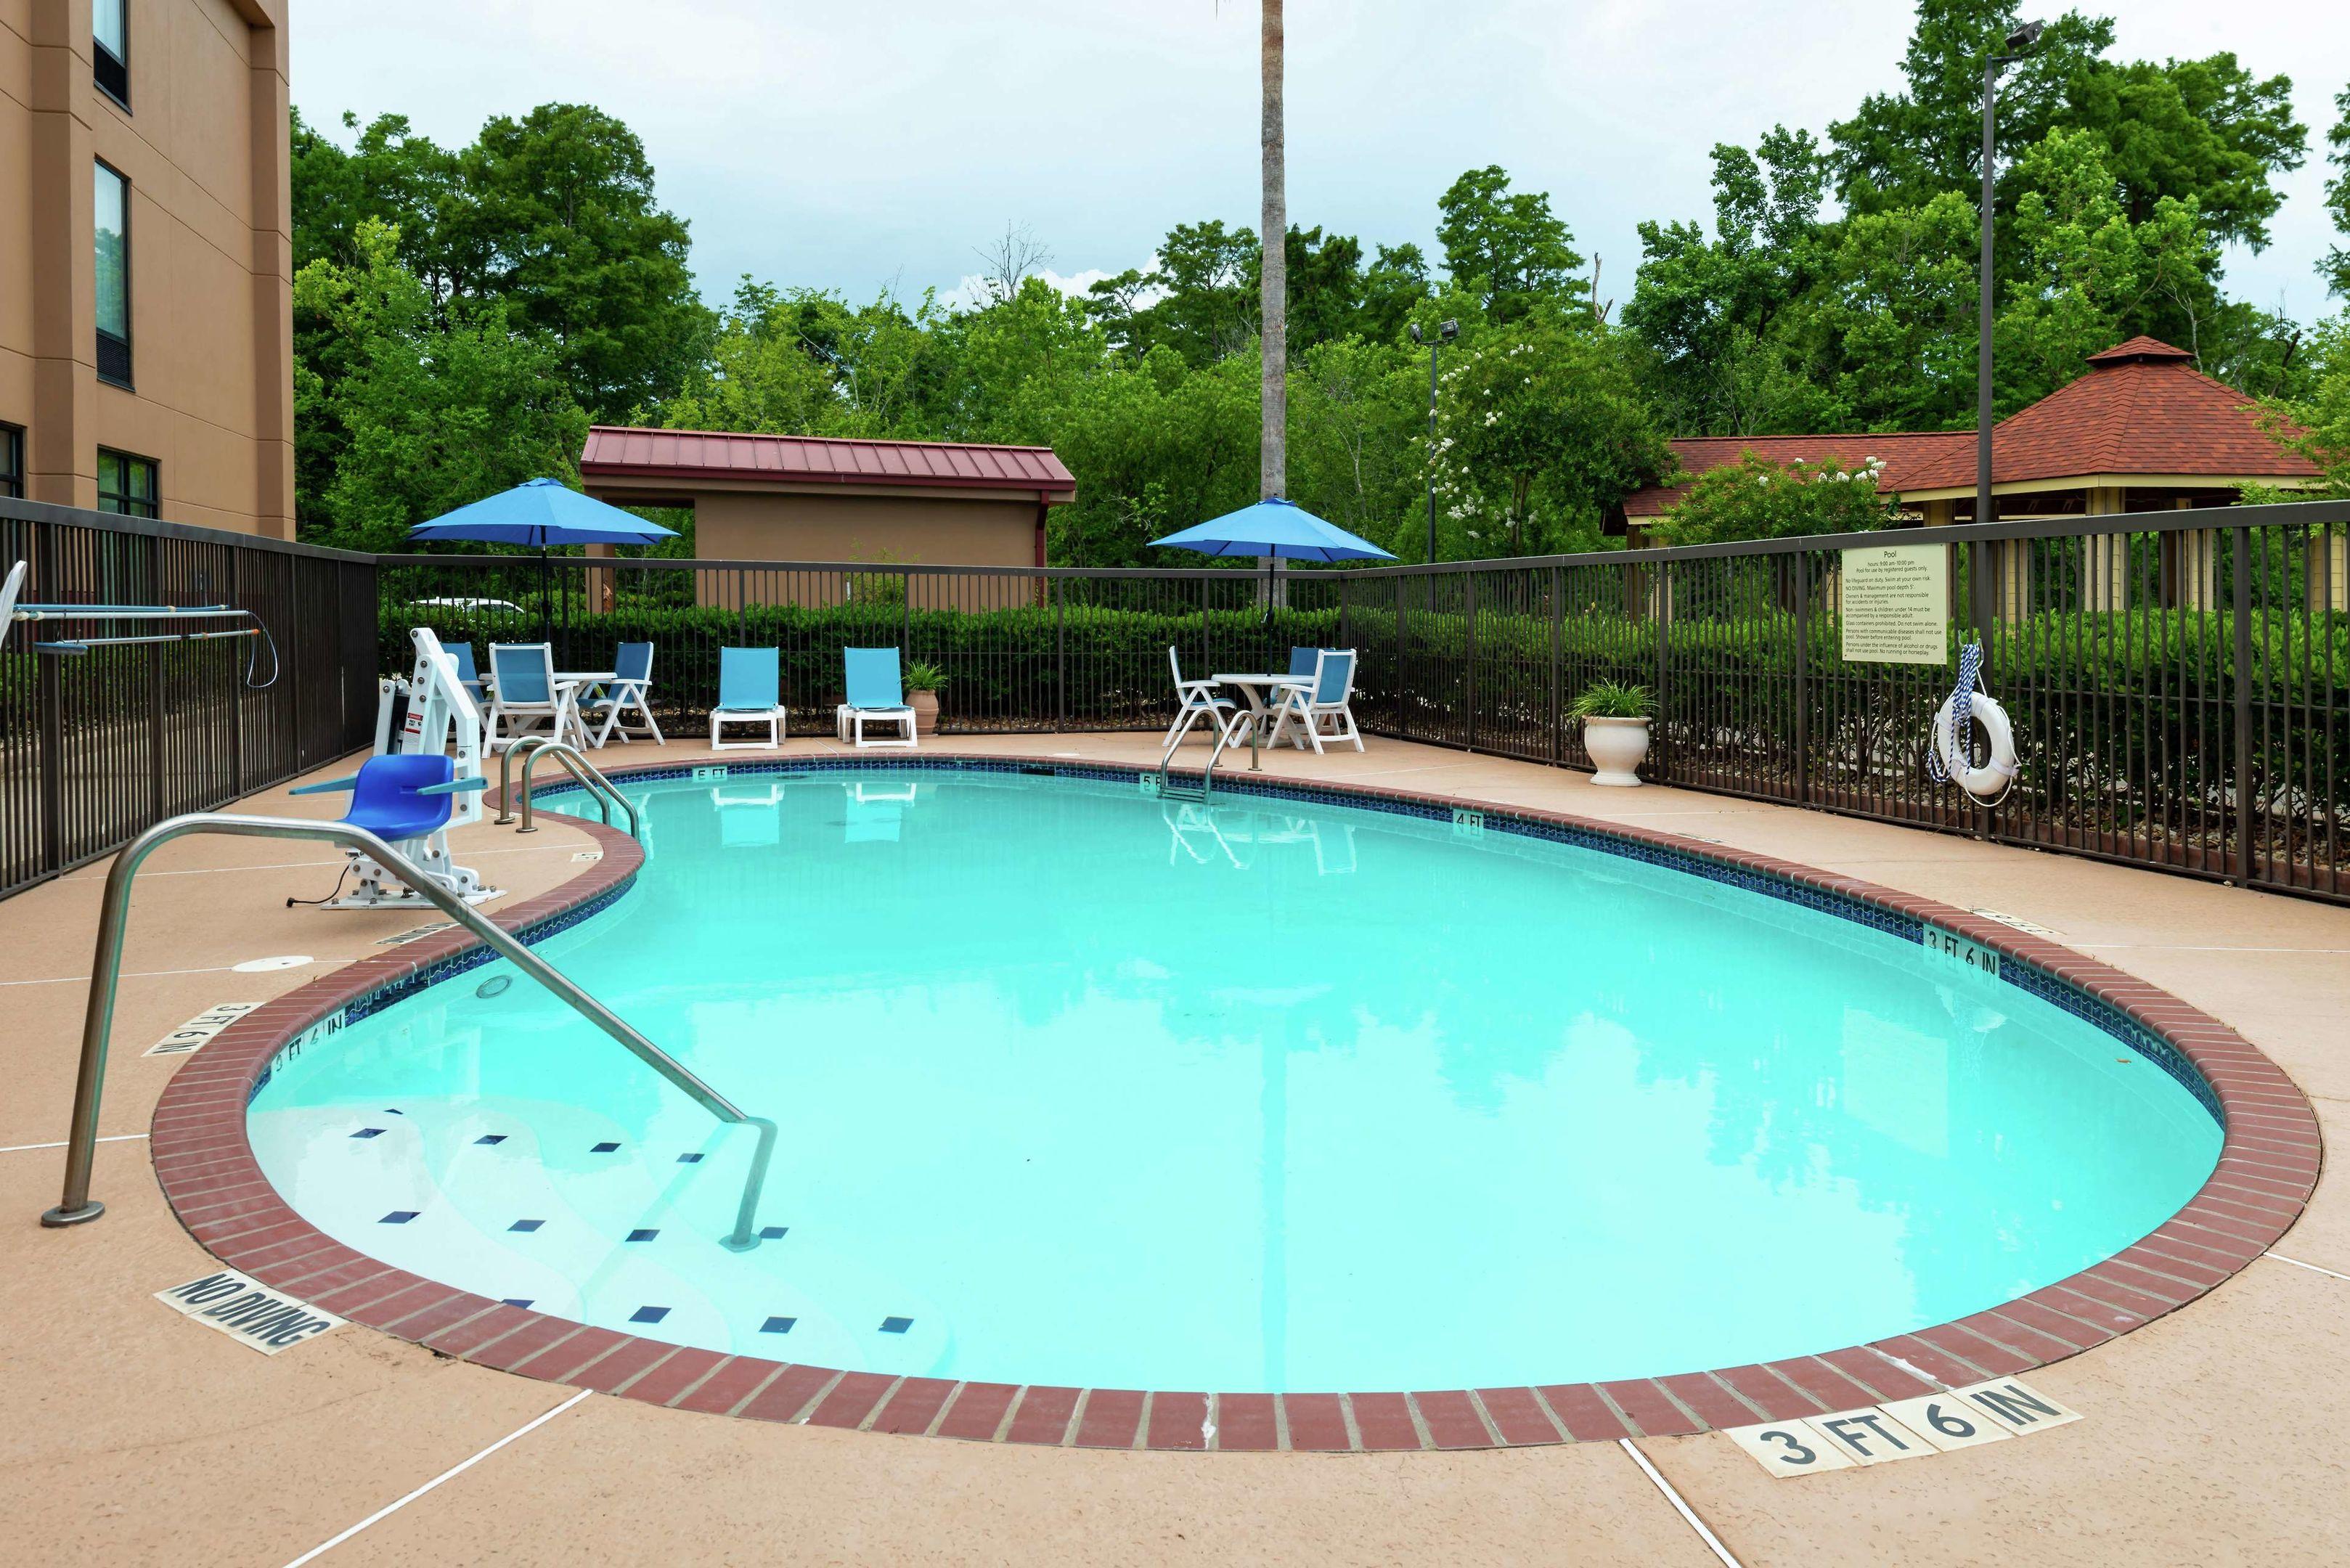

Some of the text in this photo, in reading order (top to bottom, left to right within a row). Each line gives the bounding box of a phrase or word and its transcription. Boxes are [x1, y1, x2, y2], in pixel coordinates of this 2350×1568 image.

[1143, 776, 1151, 785] 5
[1456, 813, 1481, 828] 4 FT
[1928, 930, 1996, 976] 3 FT 6 IN
[190, 1015, 237, 1026] FT
[151, 1041, 201, 1054] IN
[288, 1037, 302, 1061] FT
[327, 1014, 343, 1036] IN
[168, 1273, 331, 1347] NO DIVING
[1760, 1384, 2063, 1466] 3 FT 6 IN
